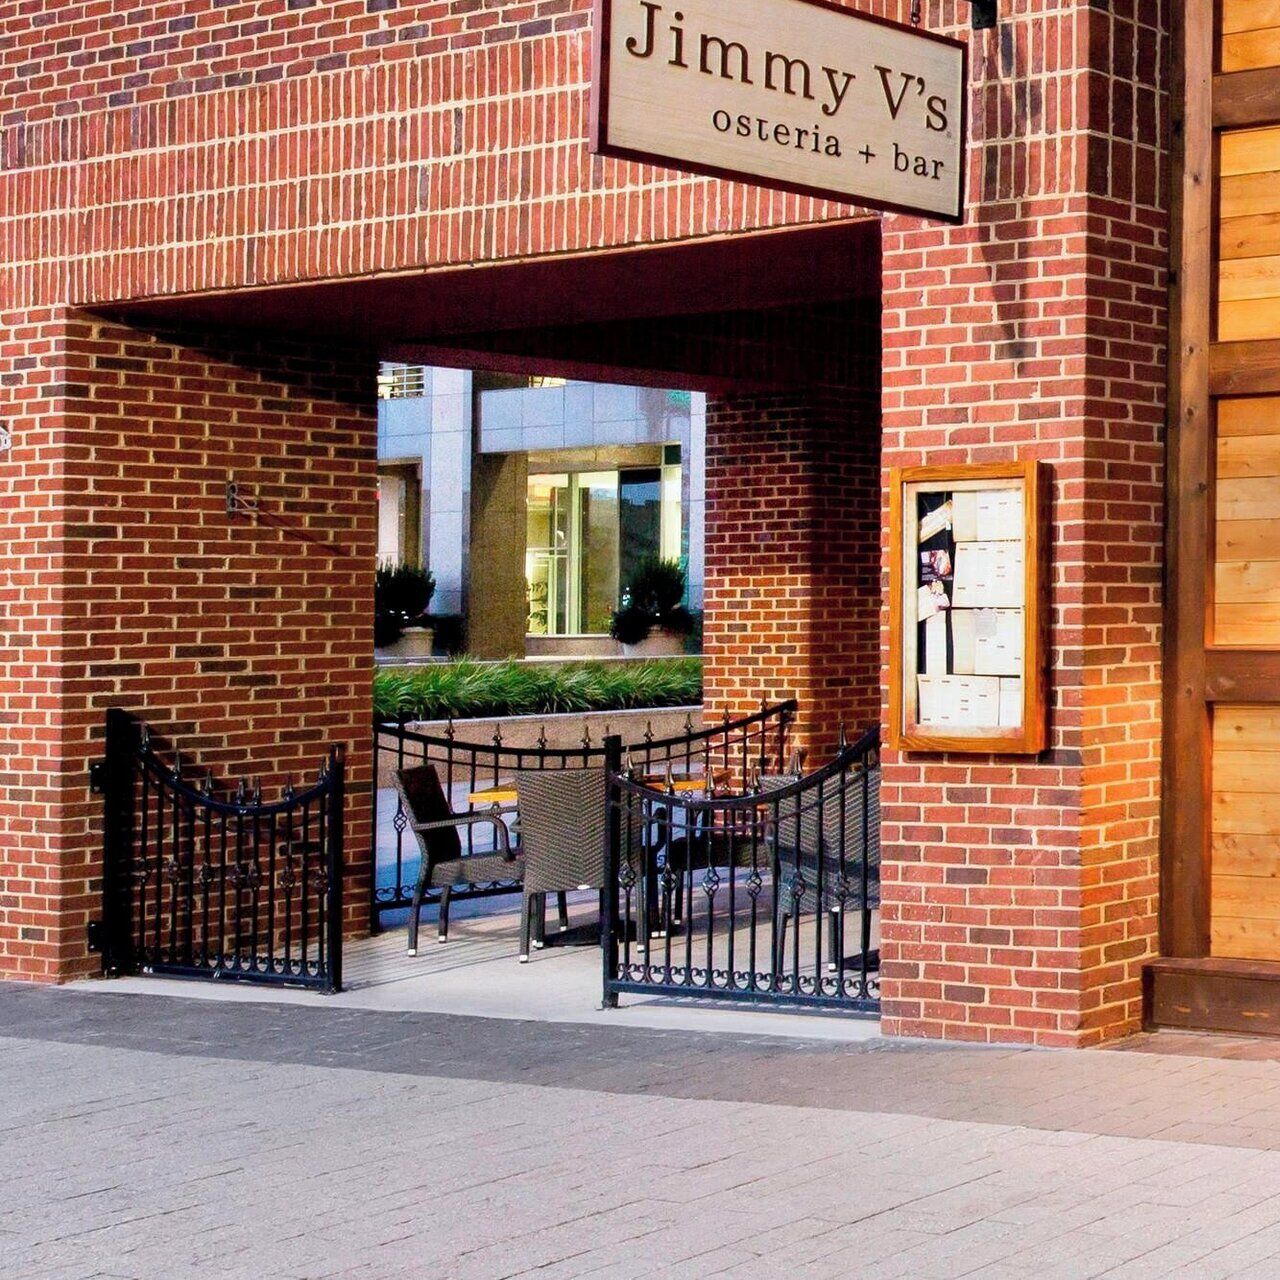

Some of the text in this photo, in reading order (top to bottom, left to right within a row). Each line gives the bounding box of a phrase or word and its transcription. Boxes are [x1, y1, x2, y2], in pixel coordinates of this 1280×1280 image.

[625, 0, 949, 132] Jimmy V’s
[712, 109, 945, 180] osteria + bar
